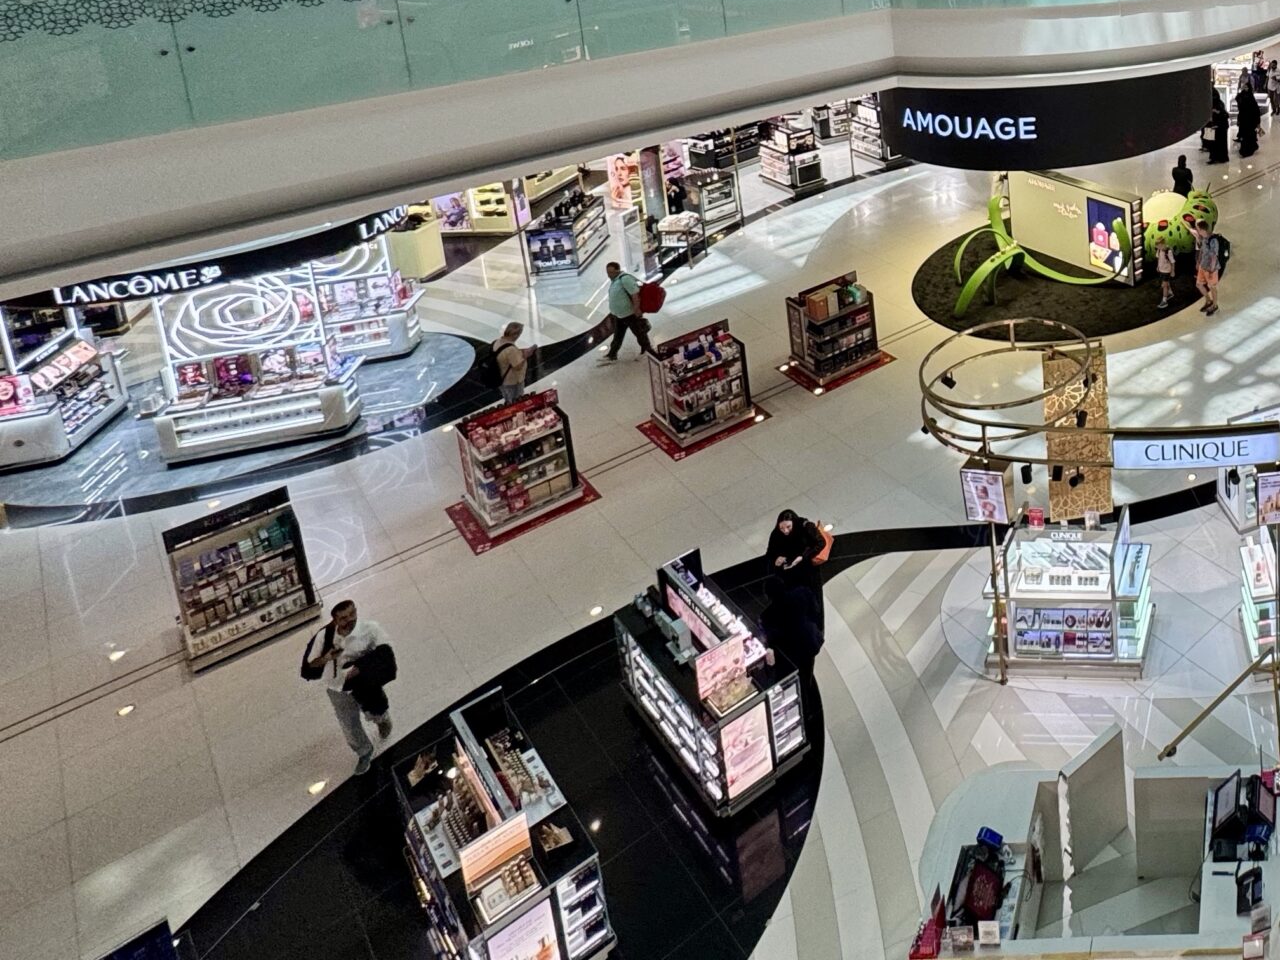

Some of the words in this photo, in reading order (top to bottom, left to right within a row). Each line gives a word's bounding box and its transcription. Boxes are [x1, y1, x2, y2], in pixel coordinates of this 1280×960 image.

[902, 107, 1038, 140] AMOUAGE
[53, 269, 200, 305] LANCÔME
[1144, 439, 1249, 462] CLINIQUE
[1050, 532, 1083, 541] CLINIQUE
